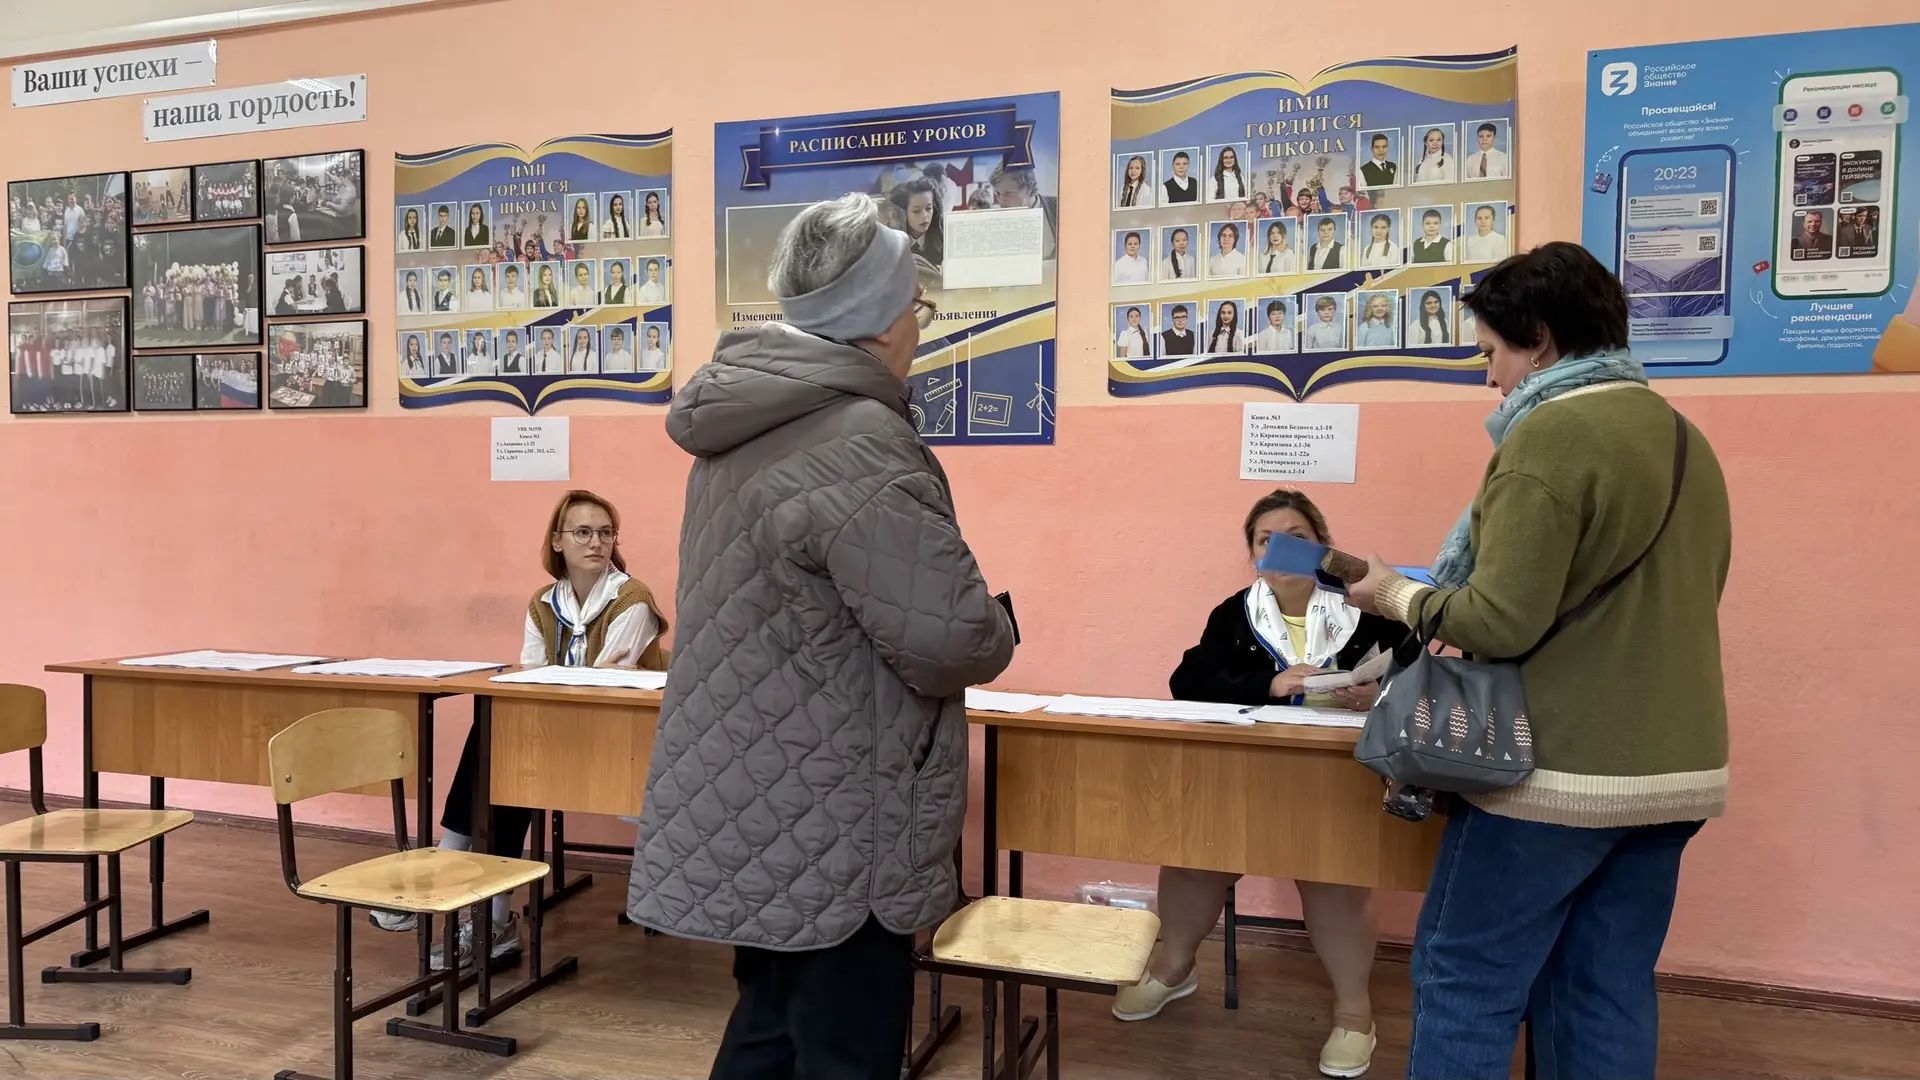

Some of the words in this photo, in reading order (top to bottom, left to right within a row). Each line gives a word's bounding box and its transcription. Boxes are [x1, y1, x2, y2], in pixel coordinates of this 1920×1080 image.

[1644, 64, 1696, 72] Российское
[24, 68, 86, 93] Ваши
[94, 57, 178, 92] успехи
[1644, 72, 1686, 80] общество
[1644, 80, 1677, 88] Знание
[1803, 84, 1852, 92] Рекомендации
[153, 102, 222, 128] наша
[229, 81, 357, 125] гордость!
[1278, 94, 1330, 113] ИМИ
[1642, 102, 1716, 116] Просвещайся!
[1246, 113, 1363, 138] ГОРДИТСЯ
[1624, 122, 1663, 130] Российское
[1664, 120, 1699, 128] общество
[789, 131, 907, 154] РАСПИСАНИЕ
[913, 123, 987, 144] УРОКОВ
[1262, 138, 1345, 159] ШКОЛА
[1842, 159, 1880, 168] ЭКСКУРСИЯ
[511, 164, 546, 178] ИМИ
[1654, 166, 1697, 181] 20:23
[488, 180, 568, 198] ГОРДИТСЯ
[500, 200, 557, 215] ШКОЛА
[1810, 302, 1854, 312] Лучшие
[732, 312, 782, 322] Изменени
[932, 310, 998, 321] бъявления
[1791, 312, 1872, 324] рекомендации
[1782, 328, 1810, 336] Лекции
[978, 404, 998, 412] 2+2=
